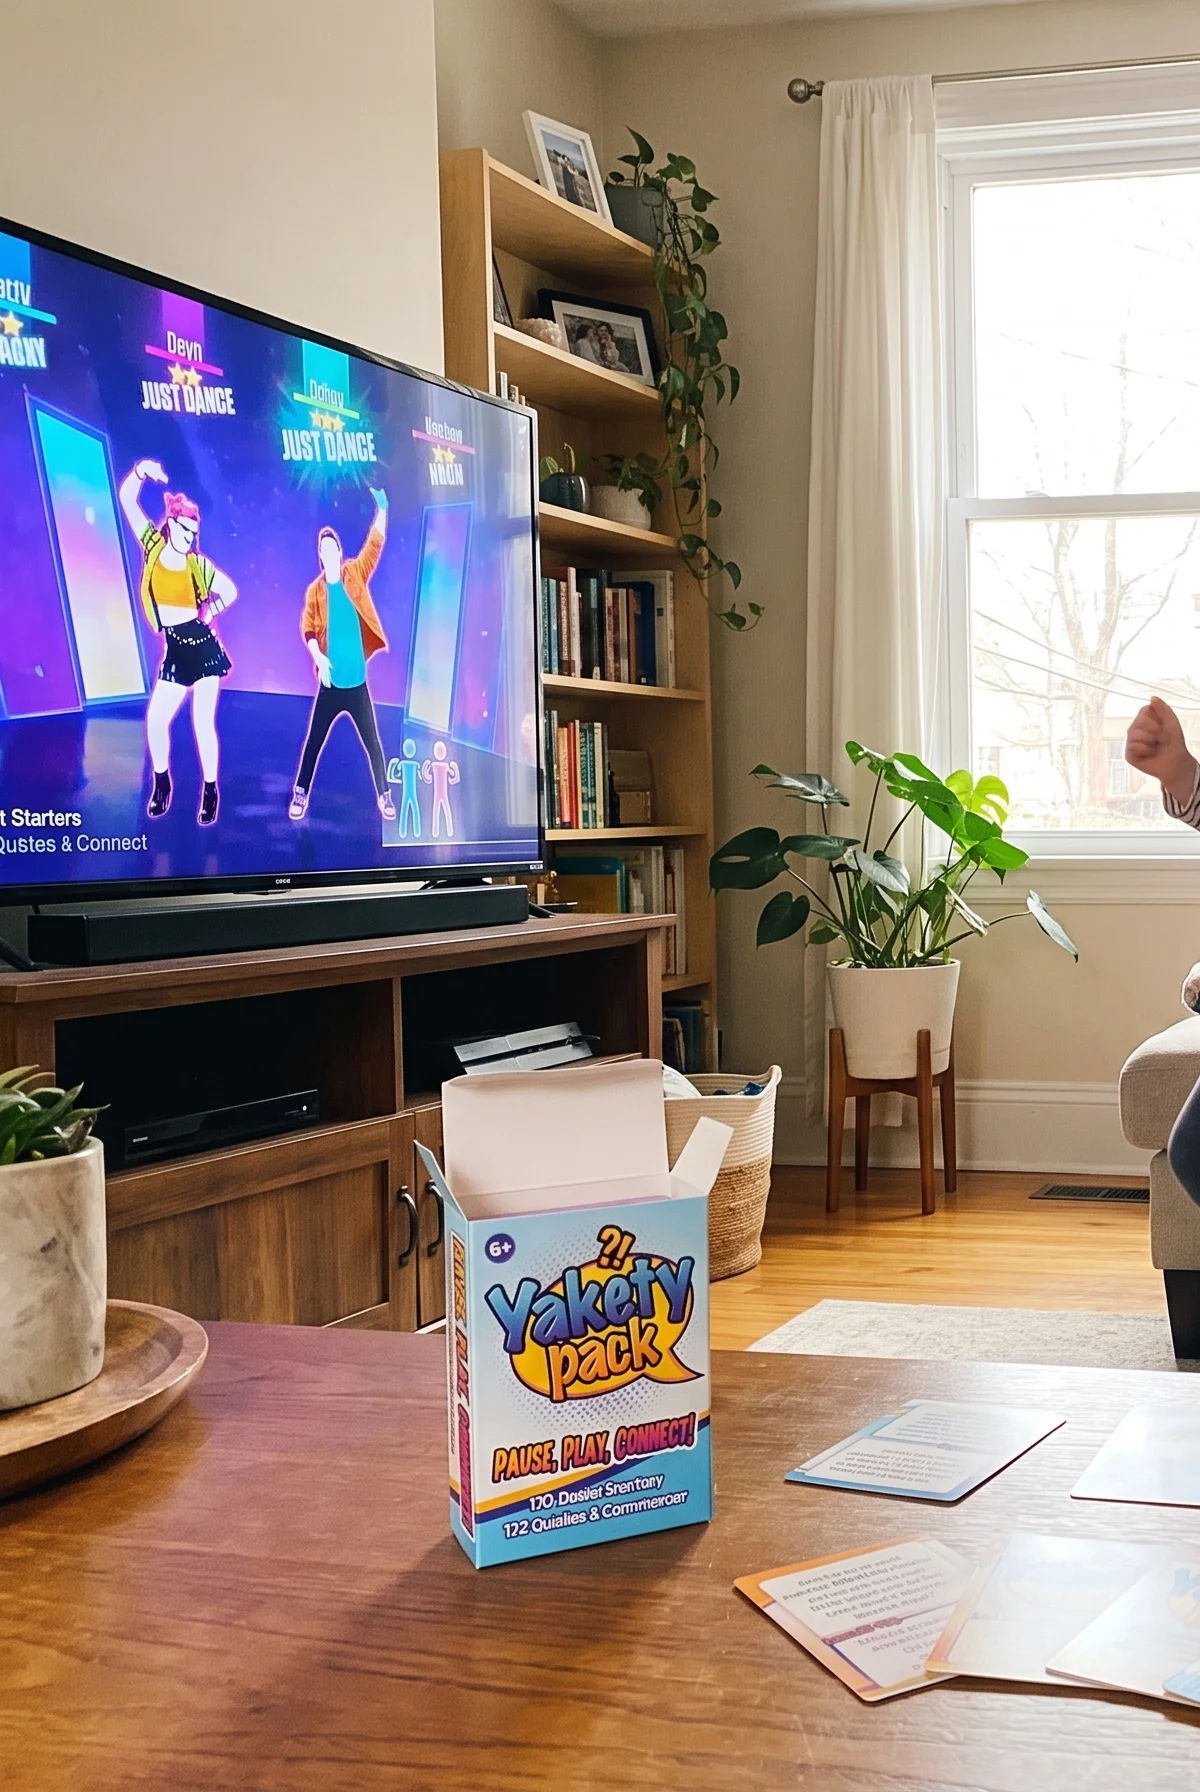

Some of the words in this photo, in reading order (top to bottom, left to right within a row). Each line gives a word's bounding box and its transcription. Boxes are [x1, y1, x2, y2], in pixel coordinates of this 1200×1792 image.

[167, 331, 203, 363] Devn
[142, 380, 181, 412] JUST
[182, 384, 236, 416] DANCE
[282, 429, 322, 462] JUST
[323, 430, 377, 467] DANCE
[12, 808, 82, 827] Starters
[61, 835, 73, 852] &
[76, 833, 148, 852] Connect
[488, 1241, 513, 1257] 6+
[597, 1224, 636, 1270] ?!
[484, 1256, 695, 1355] Yakety
[546, 1316, 663, 1403] pack
[492, 1439, 558, 1483] PAUSE,
[561, 1430, 610, 1471] PLAY,
[614, 1412, 696, 1459] CONNECT!
[589, 1506, 600, 1522] &
